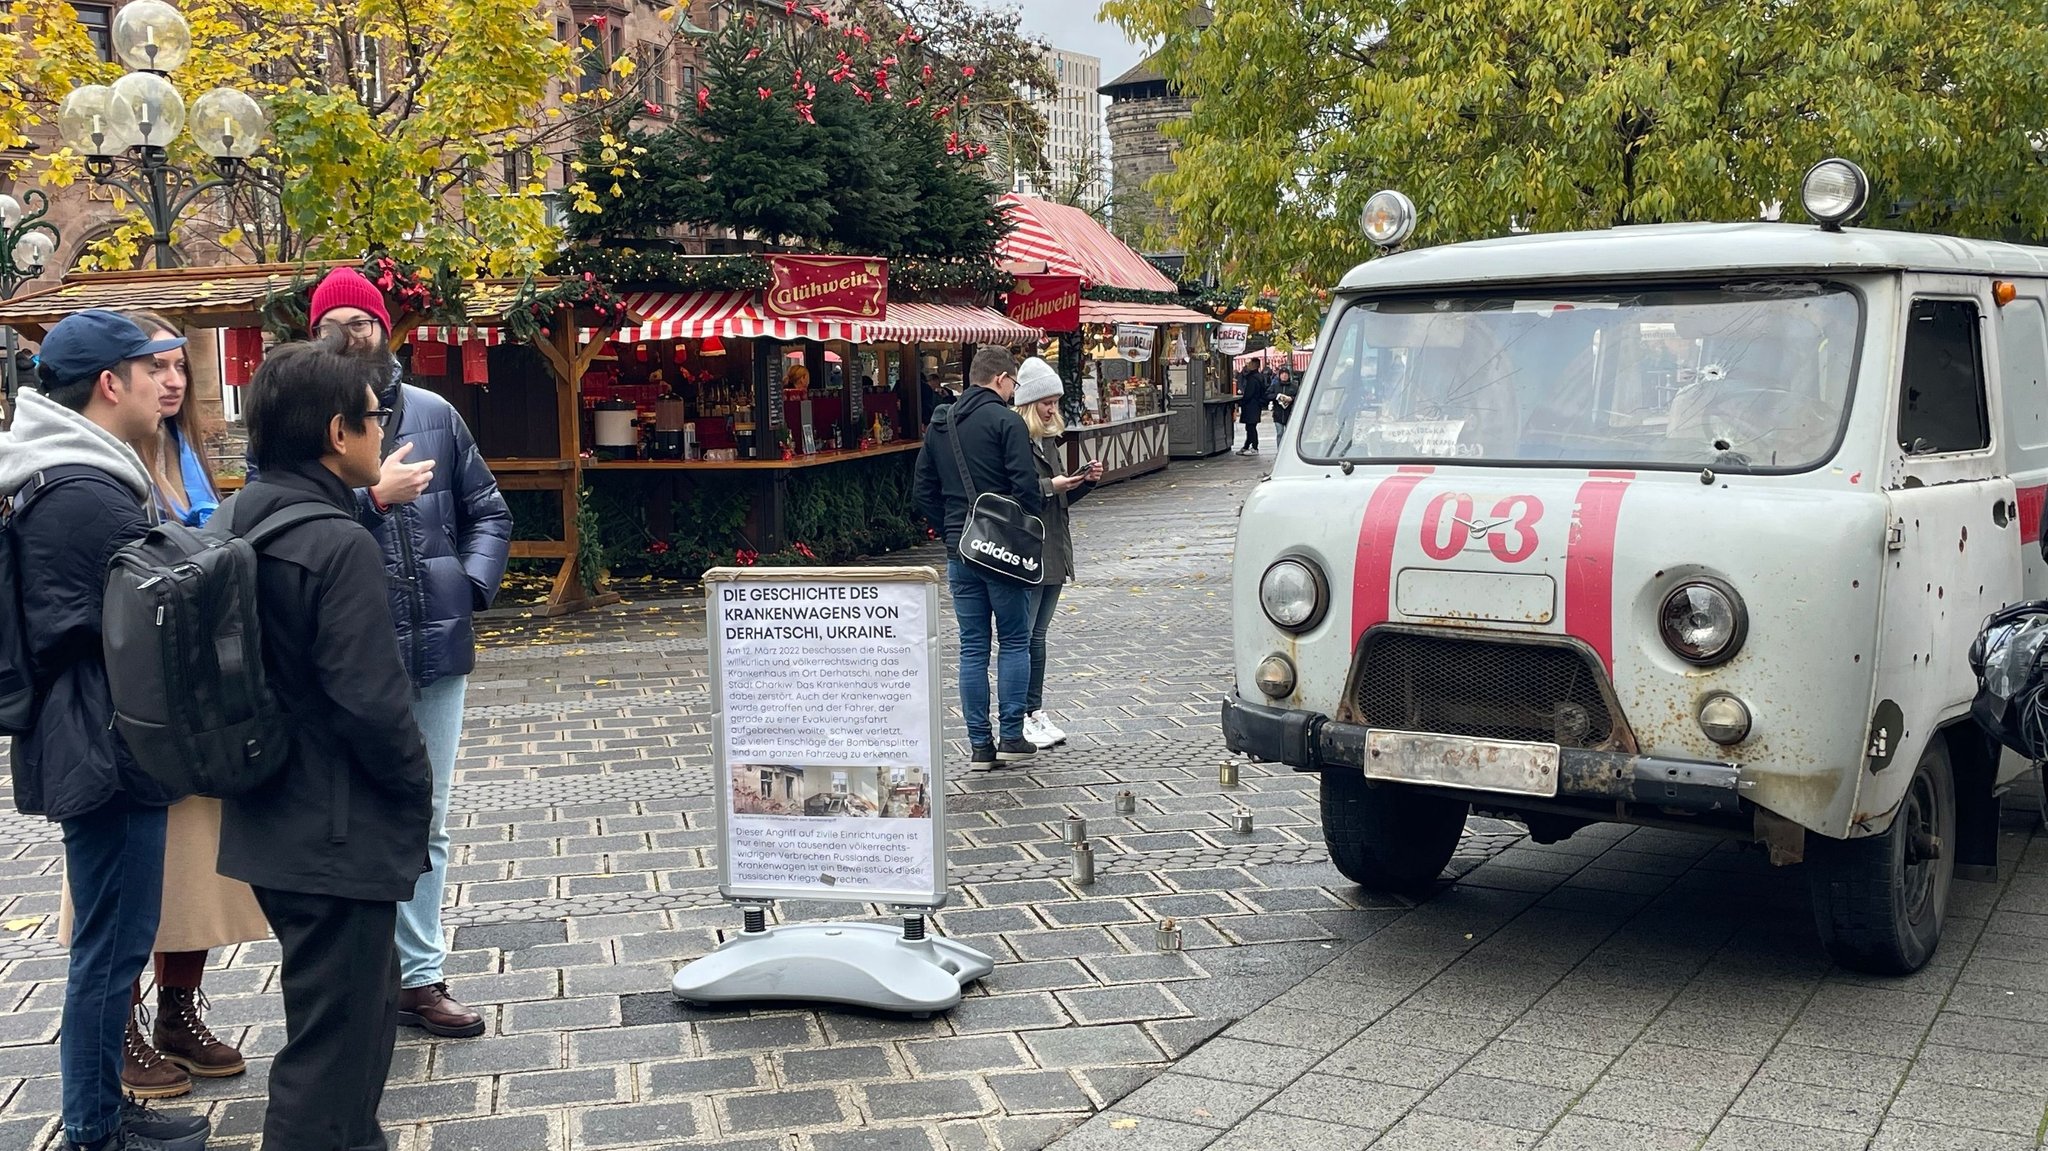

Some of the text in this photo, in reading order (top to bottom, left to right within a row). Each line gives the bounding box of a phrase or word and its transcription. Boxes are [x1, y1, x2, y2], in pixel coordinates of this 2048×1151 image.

[777, 271, 869, 304] Glühwein
[1010, 291, 1077, 323] Glühwein
[1420, 491, 1544, 563] 03
[970, 538, 1021, 566] adidas
[723, 586, 879, 602] DIE GESCHICHTE DES
[725, 605, 899, 621] KRANKENWAGENS VON
[726, 625, 897, 640] DERHATSCHI, UKRAINE.
[726, 647, 741, 655] Am
[778, 646, 799, 655] 2022
[802, 646, 858, 655] beschossen
[859, 646, 875, 654] die
[877, 646, 911, 654] Russen
[772, 658, 790, 667] und
[792, 657, 879, 668] völkerrechtswidrig
[880, 657, 899, 666] das
[728, 669, 787, 678] Krankenhaus
[789, 669, 800, 678] im
[802, 669, 818, 678] Ort
[875, 669, 900, 677] nahe
[902, 668, 919, 677] der
[728, 680, 753, 689] Stadt
[796, 681, 814, 689] Das
[816, 680, 878, 689] Krankenhaus
[880, 680, 911, 688] wurde
[729, 692, 755, 701] dabei
[795, 692, 820, 701] Auch
[822, 692, 838, 701] der
[840, 692, 912, 702] Krankenwagen
[729, 704, 758, 712] wurde
[760, 704, 802, 713] getroffen
[805, 704, 824, 712] und
[825, 704, 842, 712] der
[878, 703, 895, 712] der
[730, 715, 887, 725] gerade zu einer Evakuierungsfahrt
[830, 727, 864, 735] schwer
[747, 737, 775, 746] vielen
[828, 738, 844, 746] der
[846, 738, 919, 748] Bombensplitter
[732, 749, 751, 757] sind
[769, 750, 804, 759] ganzen
[805, 750, 848, 759] Fahrzeug
[862, 750, 909, 759] erkennen.
[736, 828, 918, 841] Dieser Angriff auf zivile Einrichtungen ist
[753, 839, 775, 848] einer
[778, 841, 795, 849] von
[797, 841, 847, 850] tausenden
[849, 842, 911, 852] völkerrechts-
[737, 850, 776, 860] widrigen
[778, 851, 831, 861] Verbrechen
[884, 854, 915, 863] Dieser
[737, 861, 924, 875] Krankenwagen ist ein Beweisstück dieser
[738, 872, 870, 884] russischen Kriegsvrechen.
